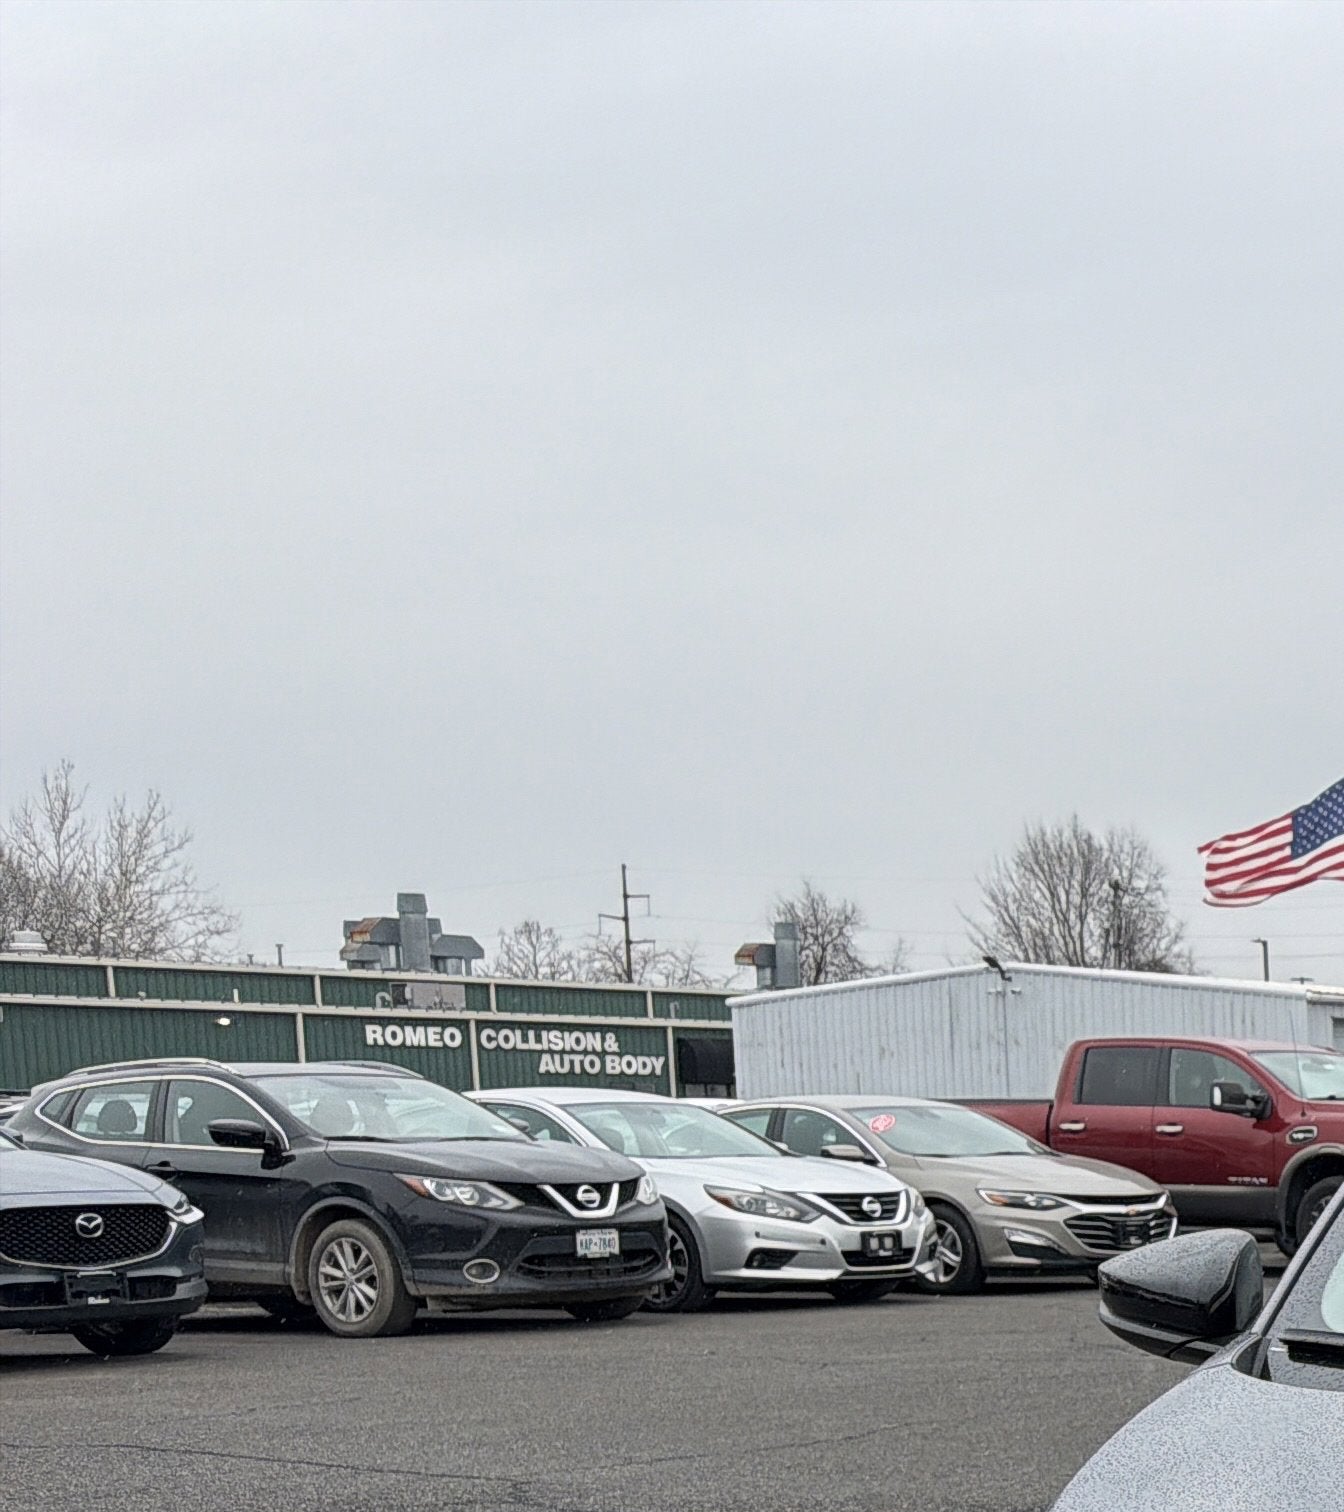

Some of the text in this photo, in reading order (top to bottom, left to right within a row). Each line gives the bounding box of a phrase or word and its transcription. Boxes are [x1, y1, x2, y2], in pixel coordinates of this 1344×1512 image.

[365, 1024, 620, 1053] ROMEO COLLISION &
[539, 1053, 665, 1076] AUTO BODY
